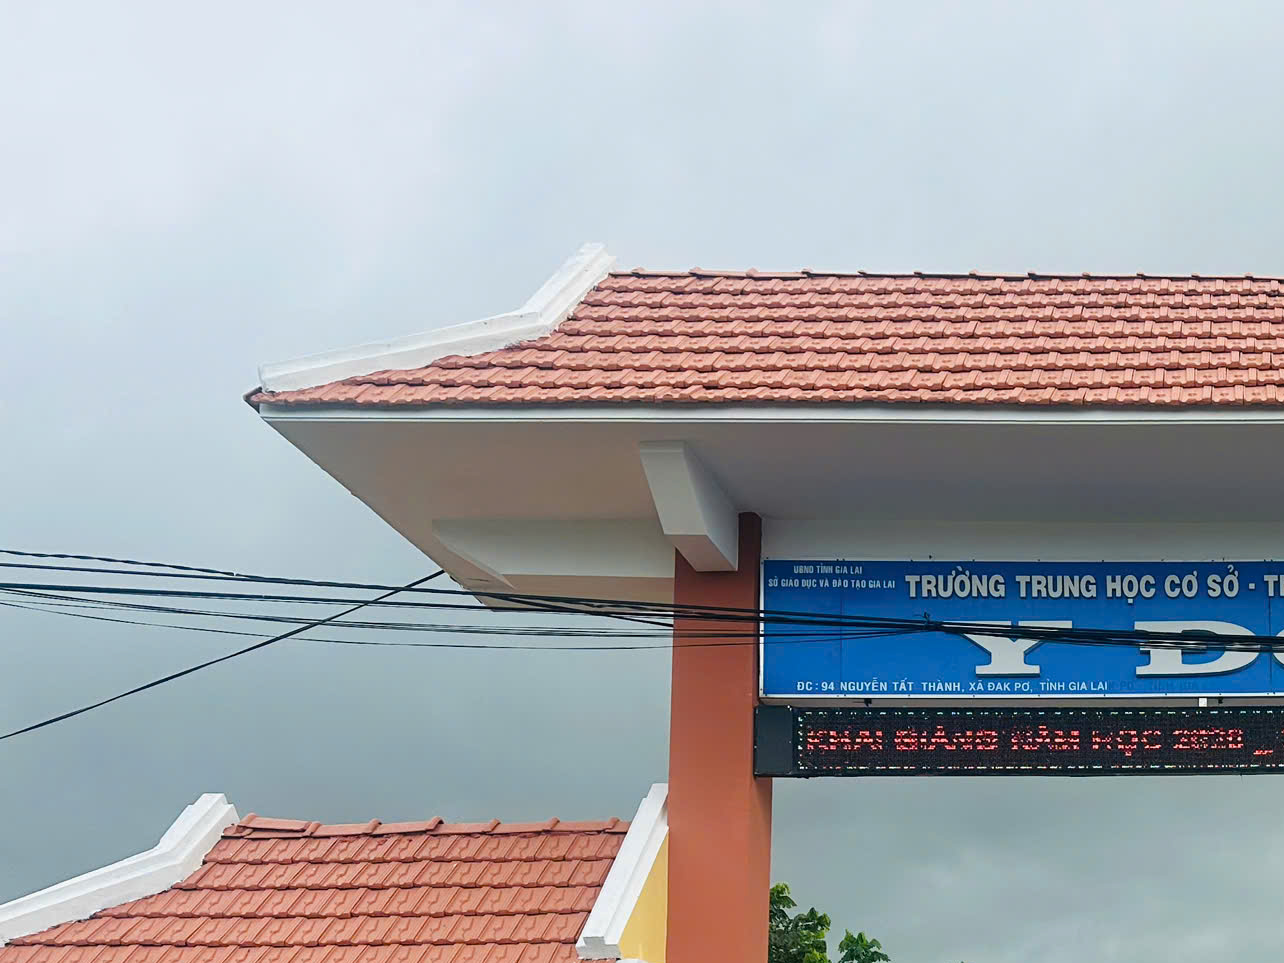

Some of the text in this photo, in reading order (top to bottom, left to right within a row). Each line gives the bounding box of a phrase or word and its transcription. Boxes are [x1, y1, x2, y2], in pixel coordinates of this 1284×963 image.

[793, 565, 815, 574] UBND
[835, 565, 848, 574] GIA
[850, 566, 863, 575] LAI
[851, 579, 867, 590] TẠO
[868, 579, 881, 589] GIA
[883, 580, 896, 589] LAI
[905, 566, 1006, 599] TRƯỜNG
[1016, 574, 1097, 599] TRUNG
[1106, 574, 1156, 604] HỌC
[1164, 570, 1198, 598] CƠ
[1207, 564, 1240, 598] SỞ
[943, 620, 1074, 677] Y
[821, 681, 835, 692] 94
[840, 677, 888, 692] NGUYỄN
[892, 677, 914, 691] TẤT
[968, 678, 985, 692] XÃ
[987, 681, 1011, 692] ĐAK
[1068, 681, 1088, 692] GIA
[1090, 681, 1108, 691] LAI
